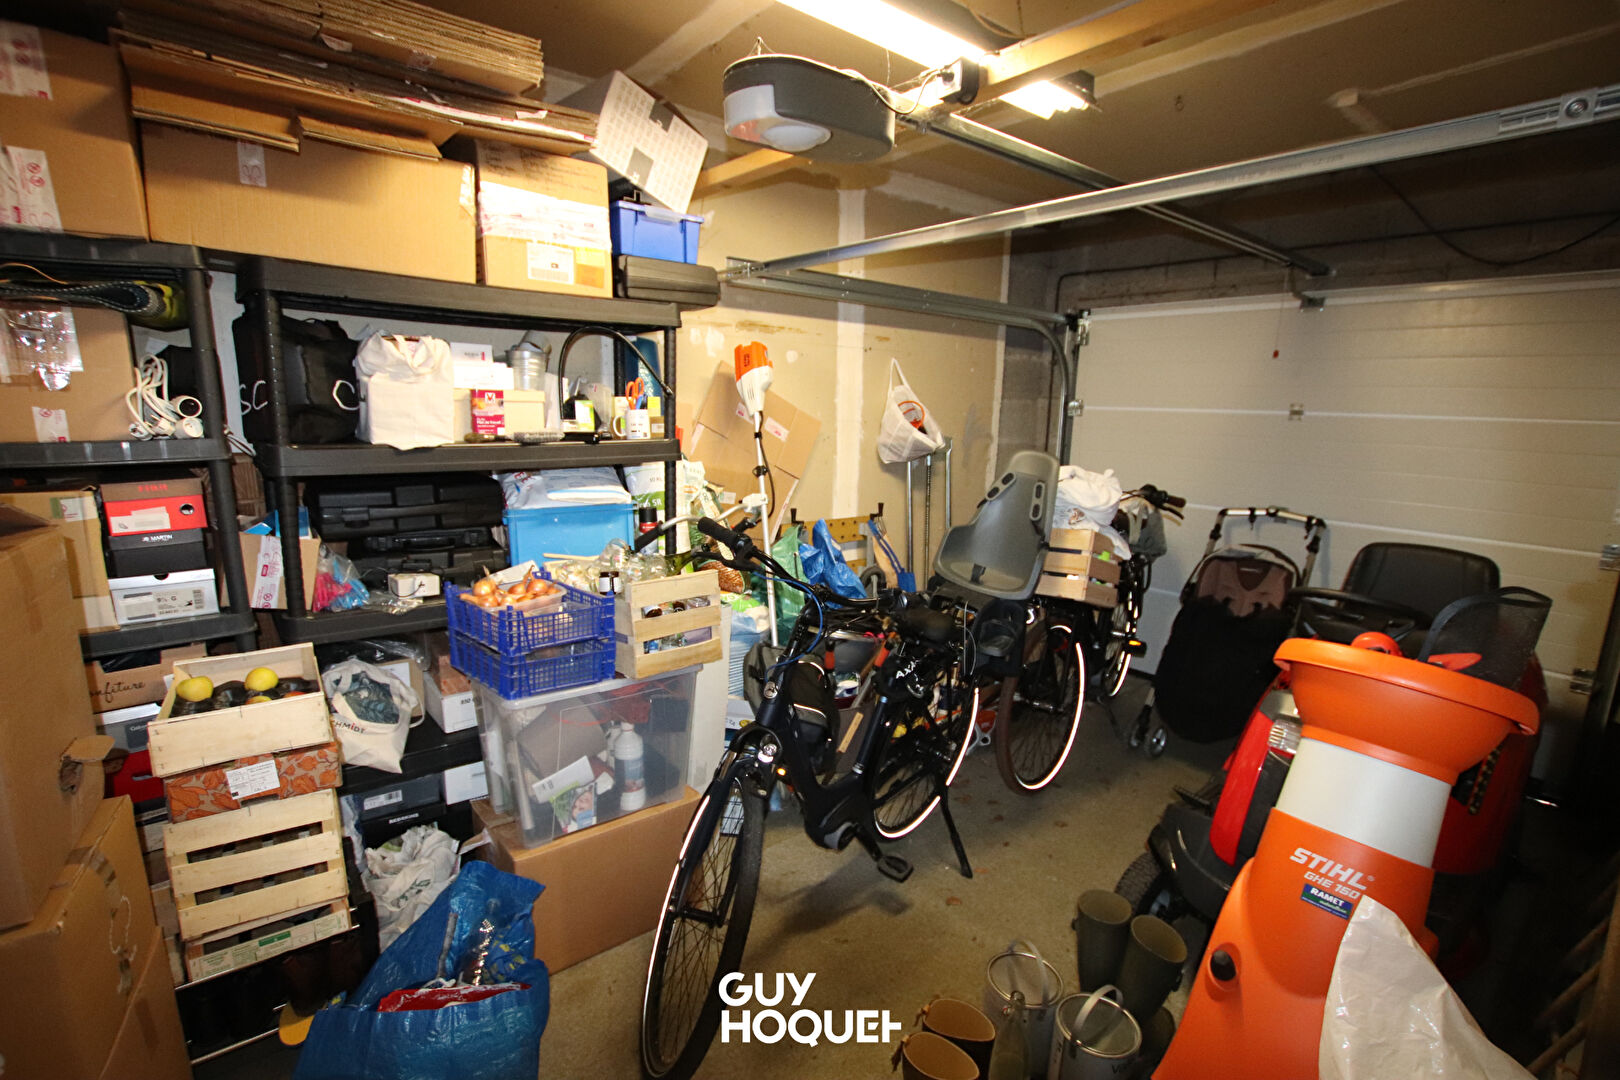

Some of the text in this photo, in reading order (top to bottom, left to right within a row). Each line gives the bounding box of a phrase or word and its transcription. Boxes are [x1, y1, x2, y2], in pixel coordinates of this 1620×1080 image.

[150, 534, 173, 542] MARTIN
[1289, 847, 1367, 890] STIHL
[1303, 871, 1361, 900] GHE 150
[1309, 887, 1346, 907] RAMET
